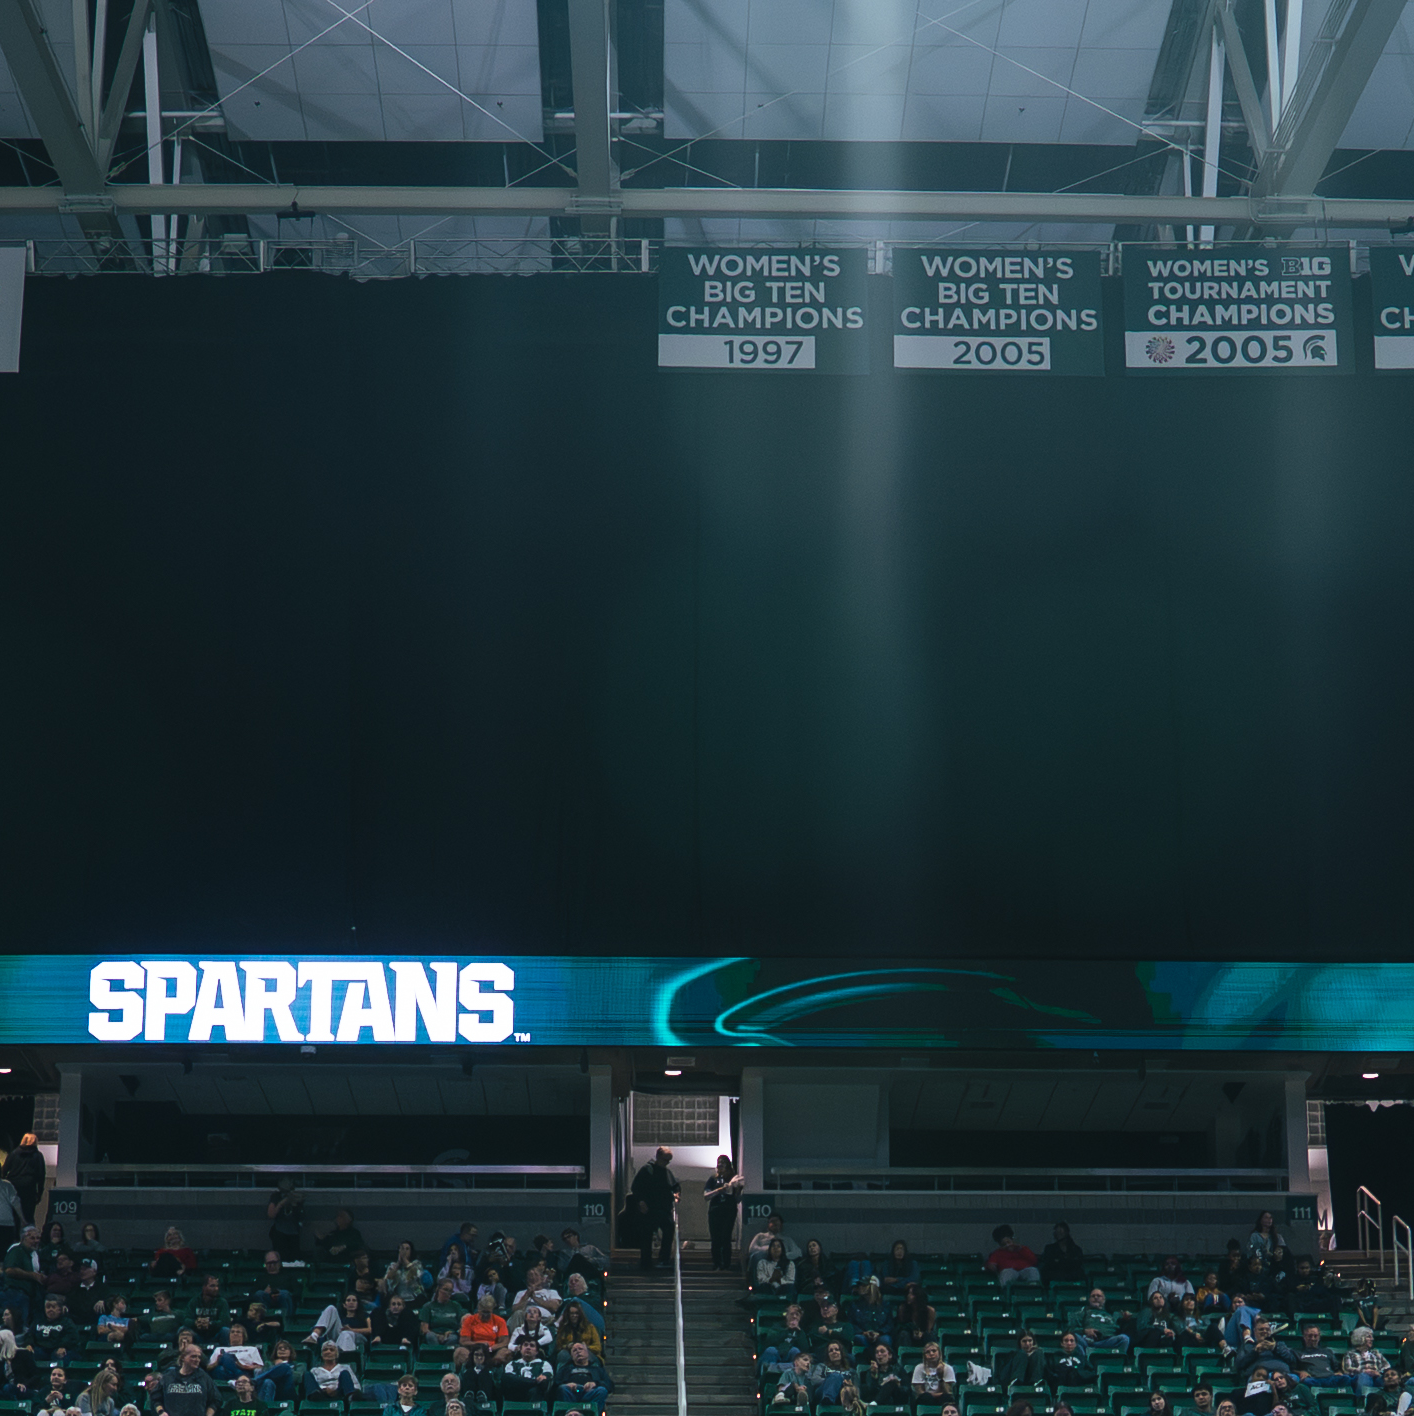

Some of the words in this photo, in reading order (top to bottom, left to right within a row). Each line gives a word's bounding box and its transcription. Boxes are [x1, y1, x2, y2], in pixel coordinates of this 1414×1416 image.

[687, 254, 841, 278] WOMEN'S
[920, 255, 1075, 280] WOMEN'S
[1147, 259, 1269, 277] WOMEN'S
[703, 280, 756, 303] BIG
[765, 280, 826, 303] TEN
[937, 281, 991, 305] BIG
[999, 282, 1060, 305] TEN
[1147, 280, 1331, 300] TOURNAMENT
[665, 305, 865, 329] CHAMPIONS
[900, 306, 1098, 331] CHAMPIONS
[1147, 304, 1335, 326] CHAMPIONS
[723, 339, 805, 366] 1997
[953, 340, 1045, 366] 2005
[1185, 334, 1293, 365] 2005
[88, 960, 515, 1043] SPARTANS
[54, 1201, 77, 1214] 109
[583, 1203, 604, 1216] 110
[748, 1204, 772, 1217] 110
[1292, 1206, 1312, 1219] 111
